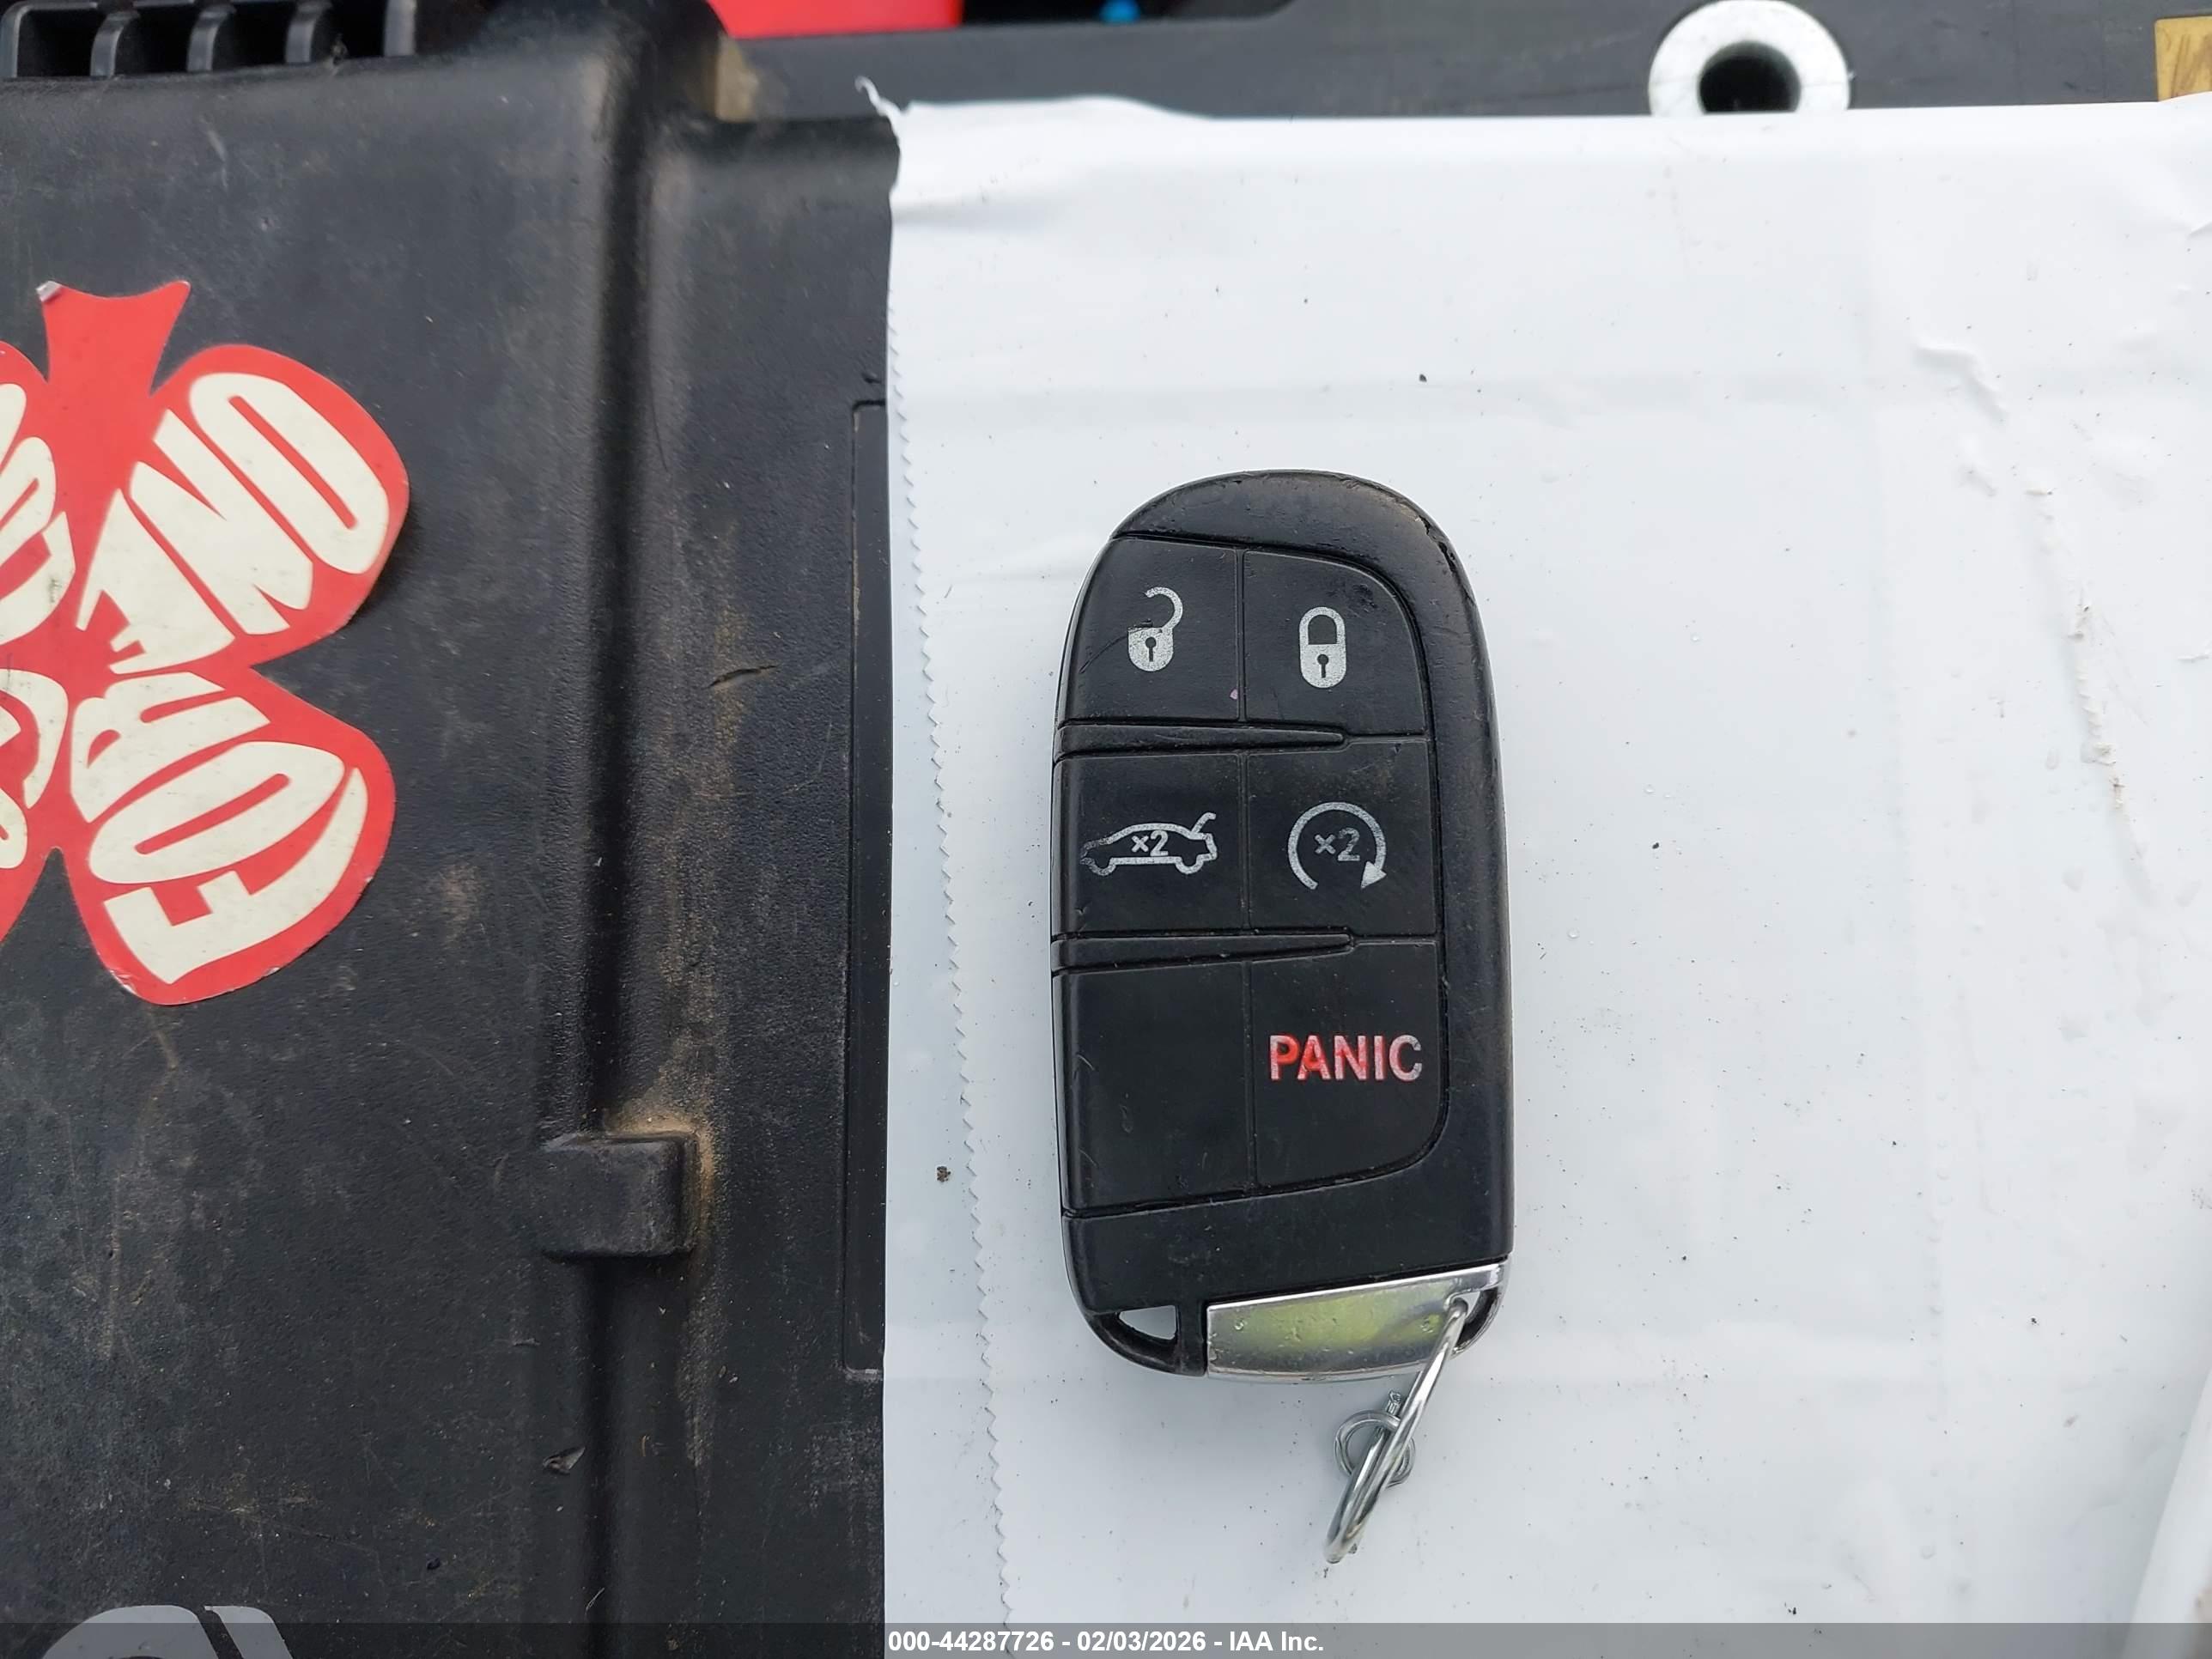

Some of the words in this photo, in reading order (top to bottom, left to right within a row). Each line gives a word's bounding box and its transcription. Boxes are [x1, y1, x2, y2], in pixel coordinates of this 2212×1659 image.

[76, 373, 390, 675] ONE
[70, 672, 368, 984] FOR
[1269, 1034, 1423, 1082] PANIC
